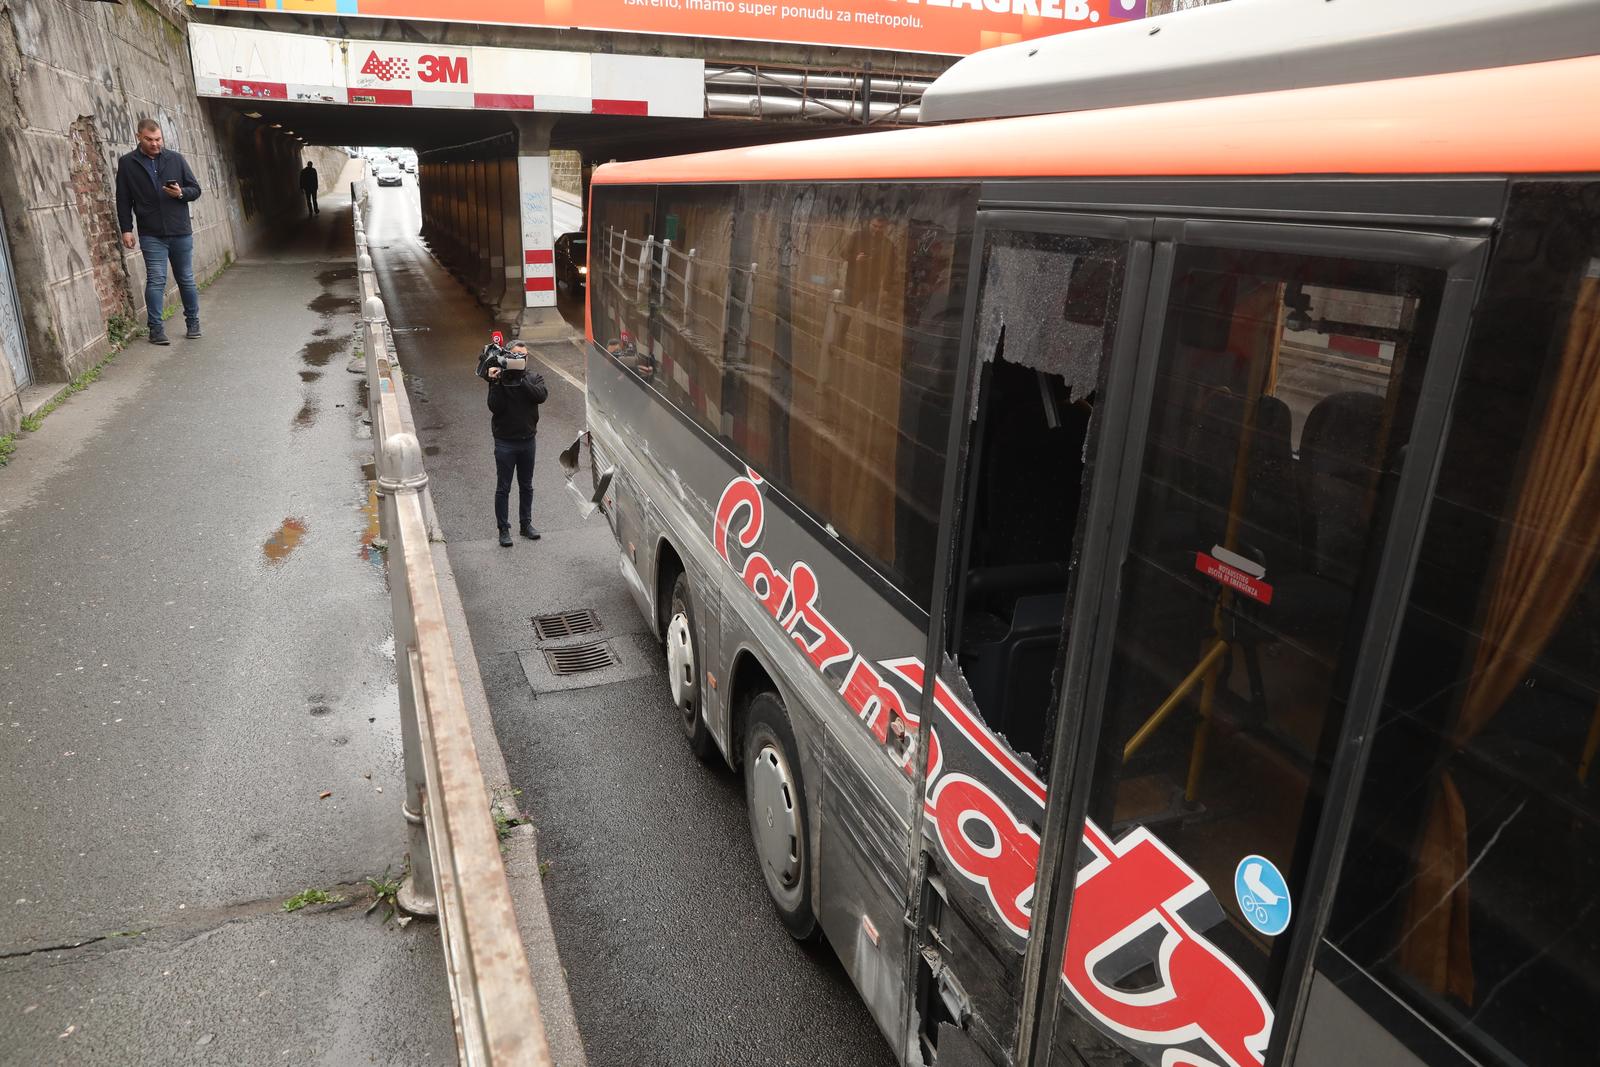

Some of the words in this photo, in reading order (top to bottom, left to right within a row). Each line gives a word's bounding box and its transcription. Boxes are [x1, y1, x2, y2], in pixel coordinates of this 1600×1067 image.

[685, 0, 735, 12] imamo
[738, 4, 777, 18] super
[781, 6, 832, 20] ponudu
[836, 10, 851, 22] za
[855, 12, 923, 28] metropolu.
[418, 55, 468, 83] 3M
[1207, 566, 1223, 580] USCITA
[1229, 578, 1258, 597] EMERGENZA
